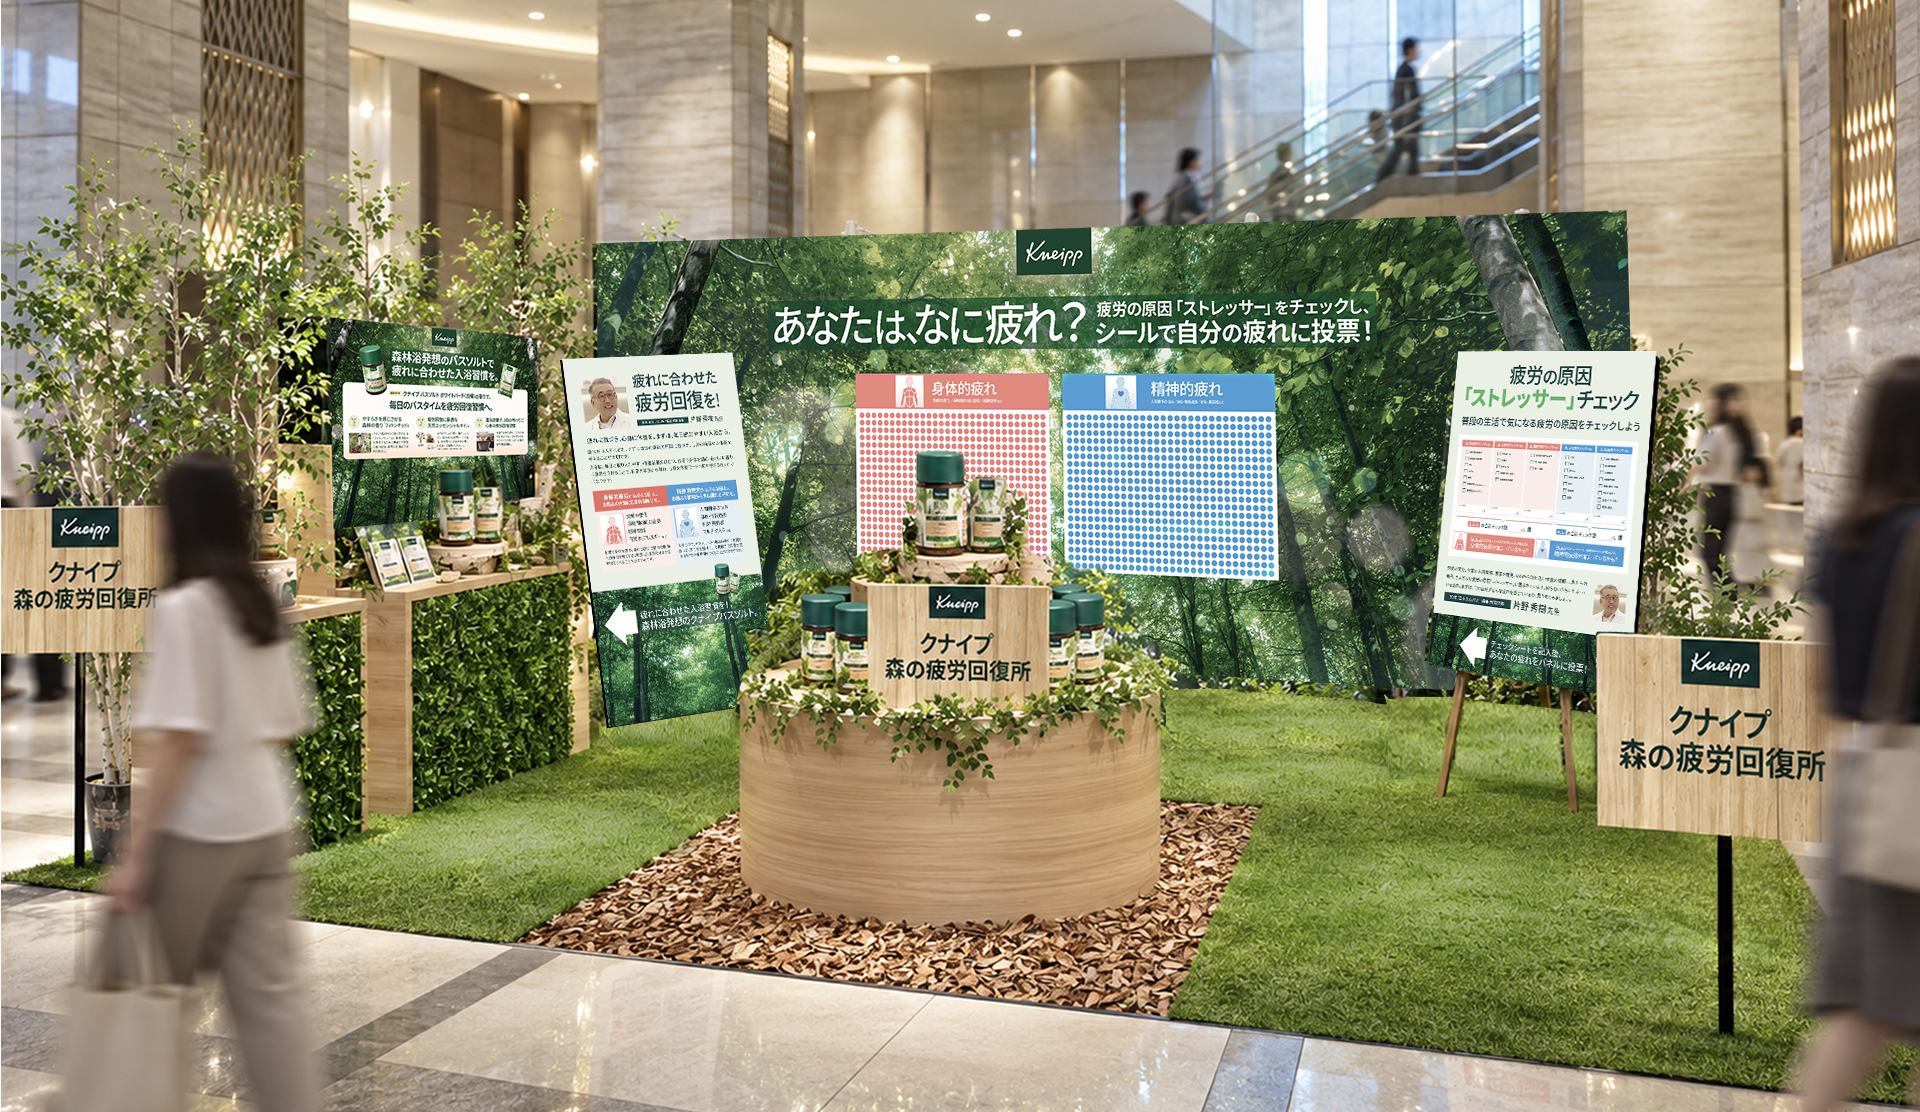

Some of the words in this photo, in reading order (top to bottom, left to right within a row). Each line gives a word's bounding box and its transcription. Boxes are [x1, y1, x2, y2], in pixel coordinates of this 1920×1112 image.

[1025, 240, 1083, 266] Kneipp
[1096, 298, 1370, 318] 疲労の原因「ストレッサー」をチェックし、
[773, 301, 1086, 345] あなたは、なに疲れ？
[1096, 318, 1372, 345] シールで自分の疲れに投票！
[391, 350, 494, 368] 森林浴発想のバスソルトで
[391, 365, 498, 382] 疲れに合わせた入浴習慣を。
[632, 371, 717, 388] 疲れに合わせた
[1509, 364, 1593, 386] 疲労の原因
[932, 381, 997, 396] 身体的疲れ
[1151, 381, 1223, 397] 精神的疲れ
[1464, 386, 1640, 411] 「ストレッサー」チェック
[635, 390, 720, 413] 疲労回復を！
[1461, 416, 1641, 432] 普段の生活で気になる疲労の原因をチェックしよう
[60, 518, 110, 540] Kneipp
[49, 560, 122, 583] クナイプ
[14, 587, 158, 610] 森の疲労回復所
[936, 595, 979, 613] Kneipp
[921, 633, 994, 654] クナイプ
[885, 658, 1031, 682] 森の疲労回復所
[1690, 651, 1750, 678] Kneipp
[1669, 705, 1772, 739] クナイプ
[1619, 738, 1826, 782] 森の疲労回復所
